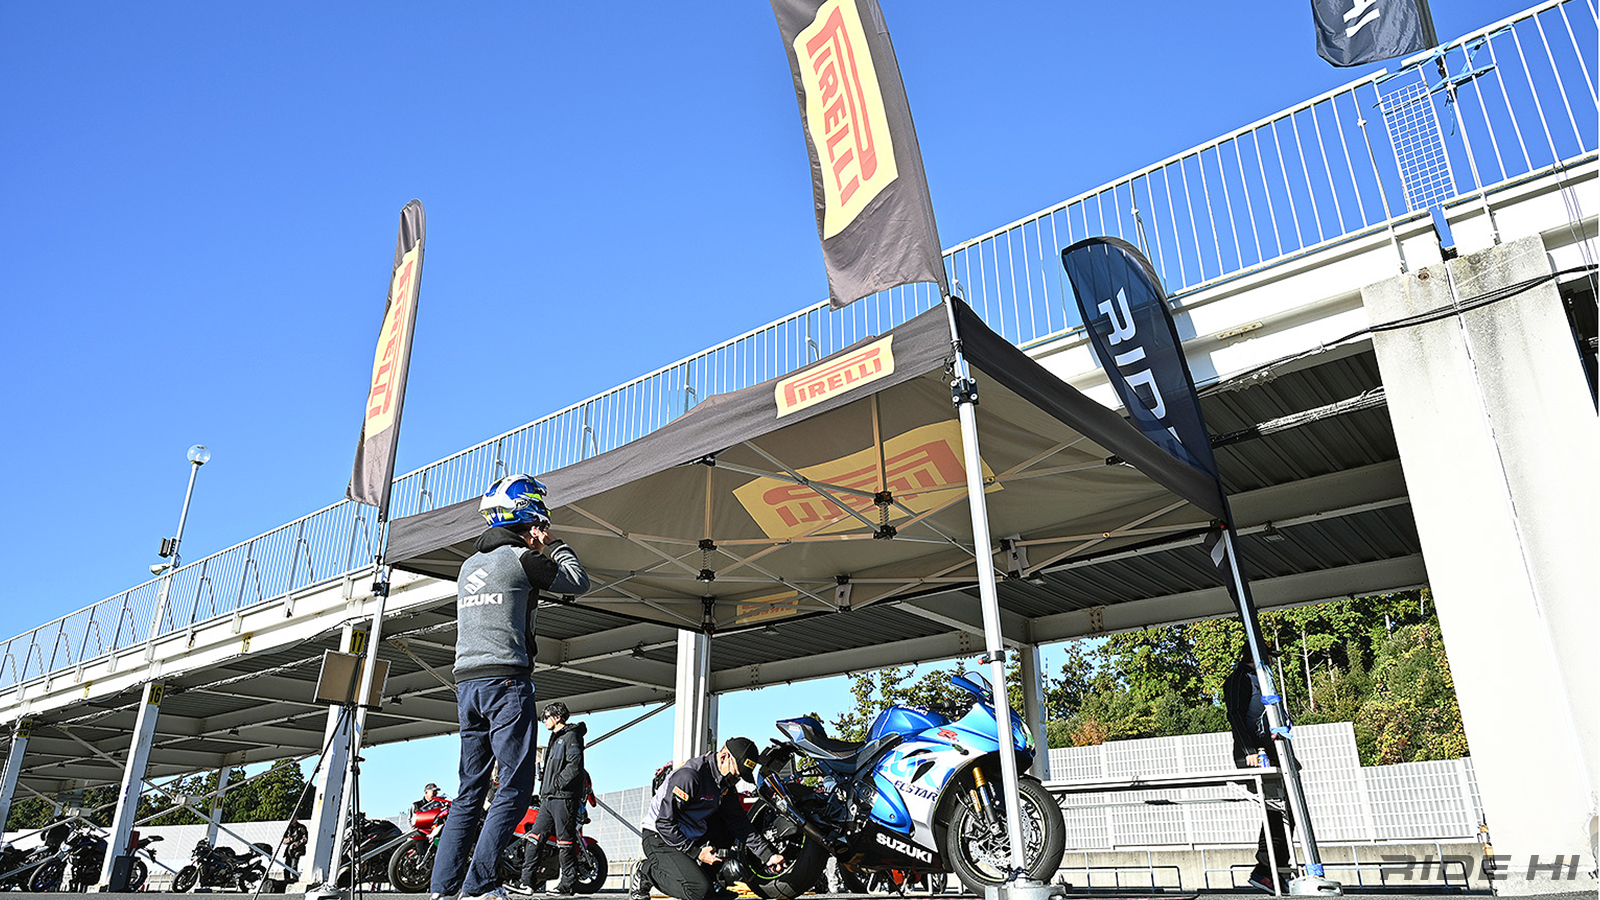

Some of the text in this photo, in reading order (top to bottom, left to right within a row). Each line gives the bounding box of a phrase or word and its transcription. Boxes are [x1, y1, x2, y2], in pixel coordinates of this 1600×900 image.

[806, 6, 878, 207] PIRELLI
[368, 260, 414, 420] PIRELLI
[1098, 287, 1183, 443] RID
[784, 347, 881, 408] PIRELLI
[352, 631, 365, 653] 17
[150, 686, 162, 703] 16
[876, 832, 933, 864] SUZUKI
